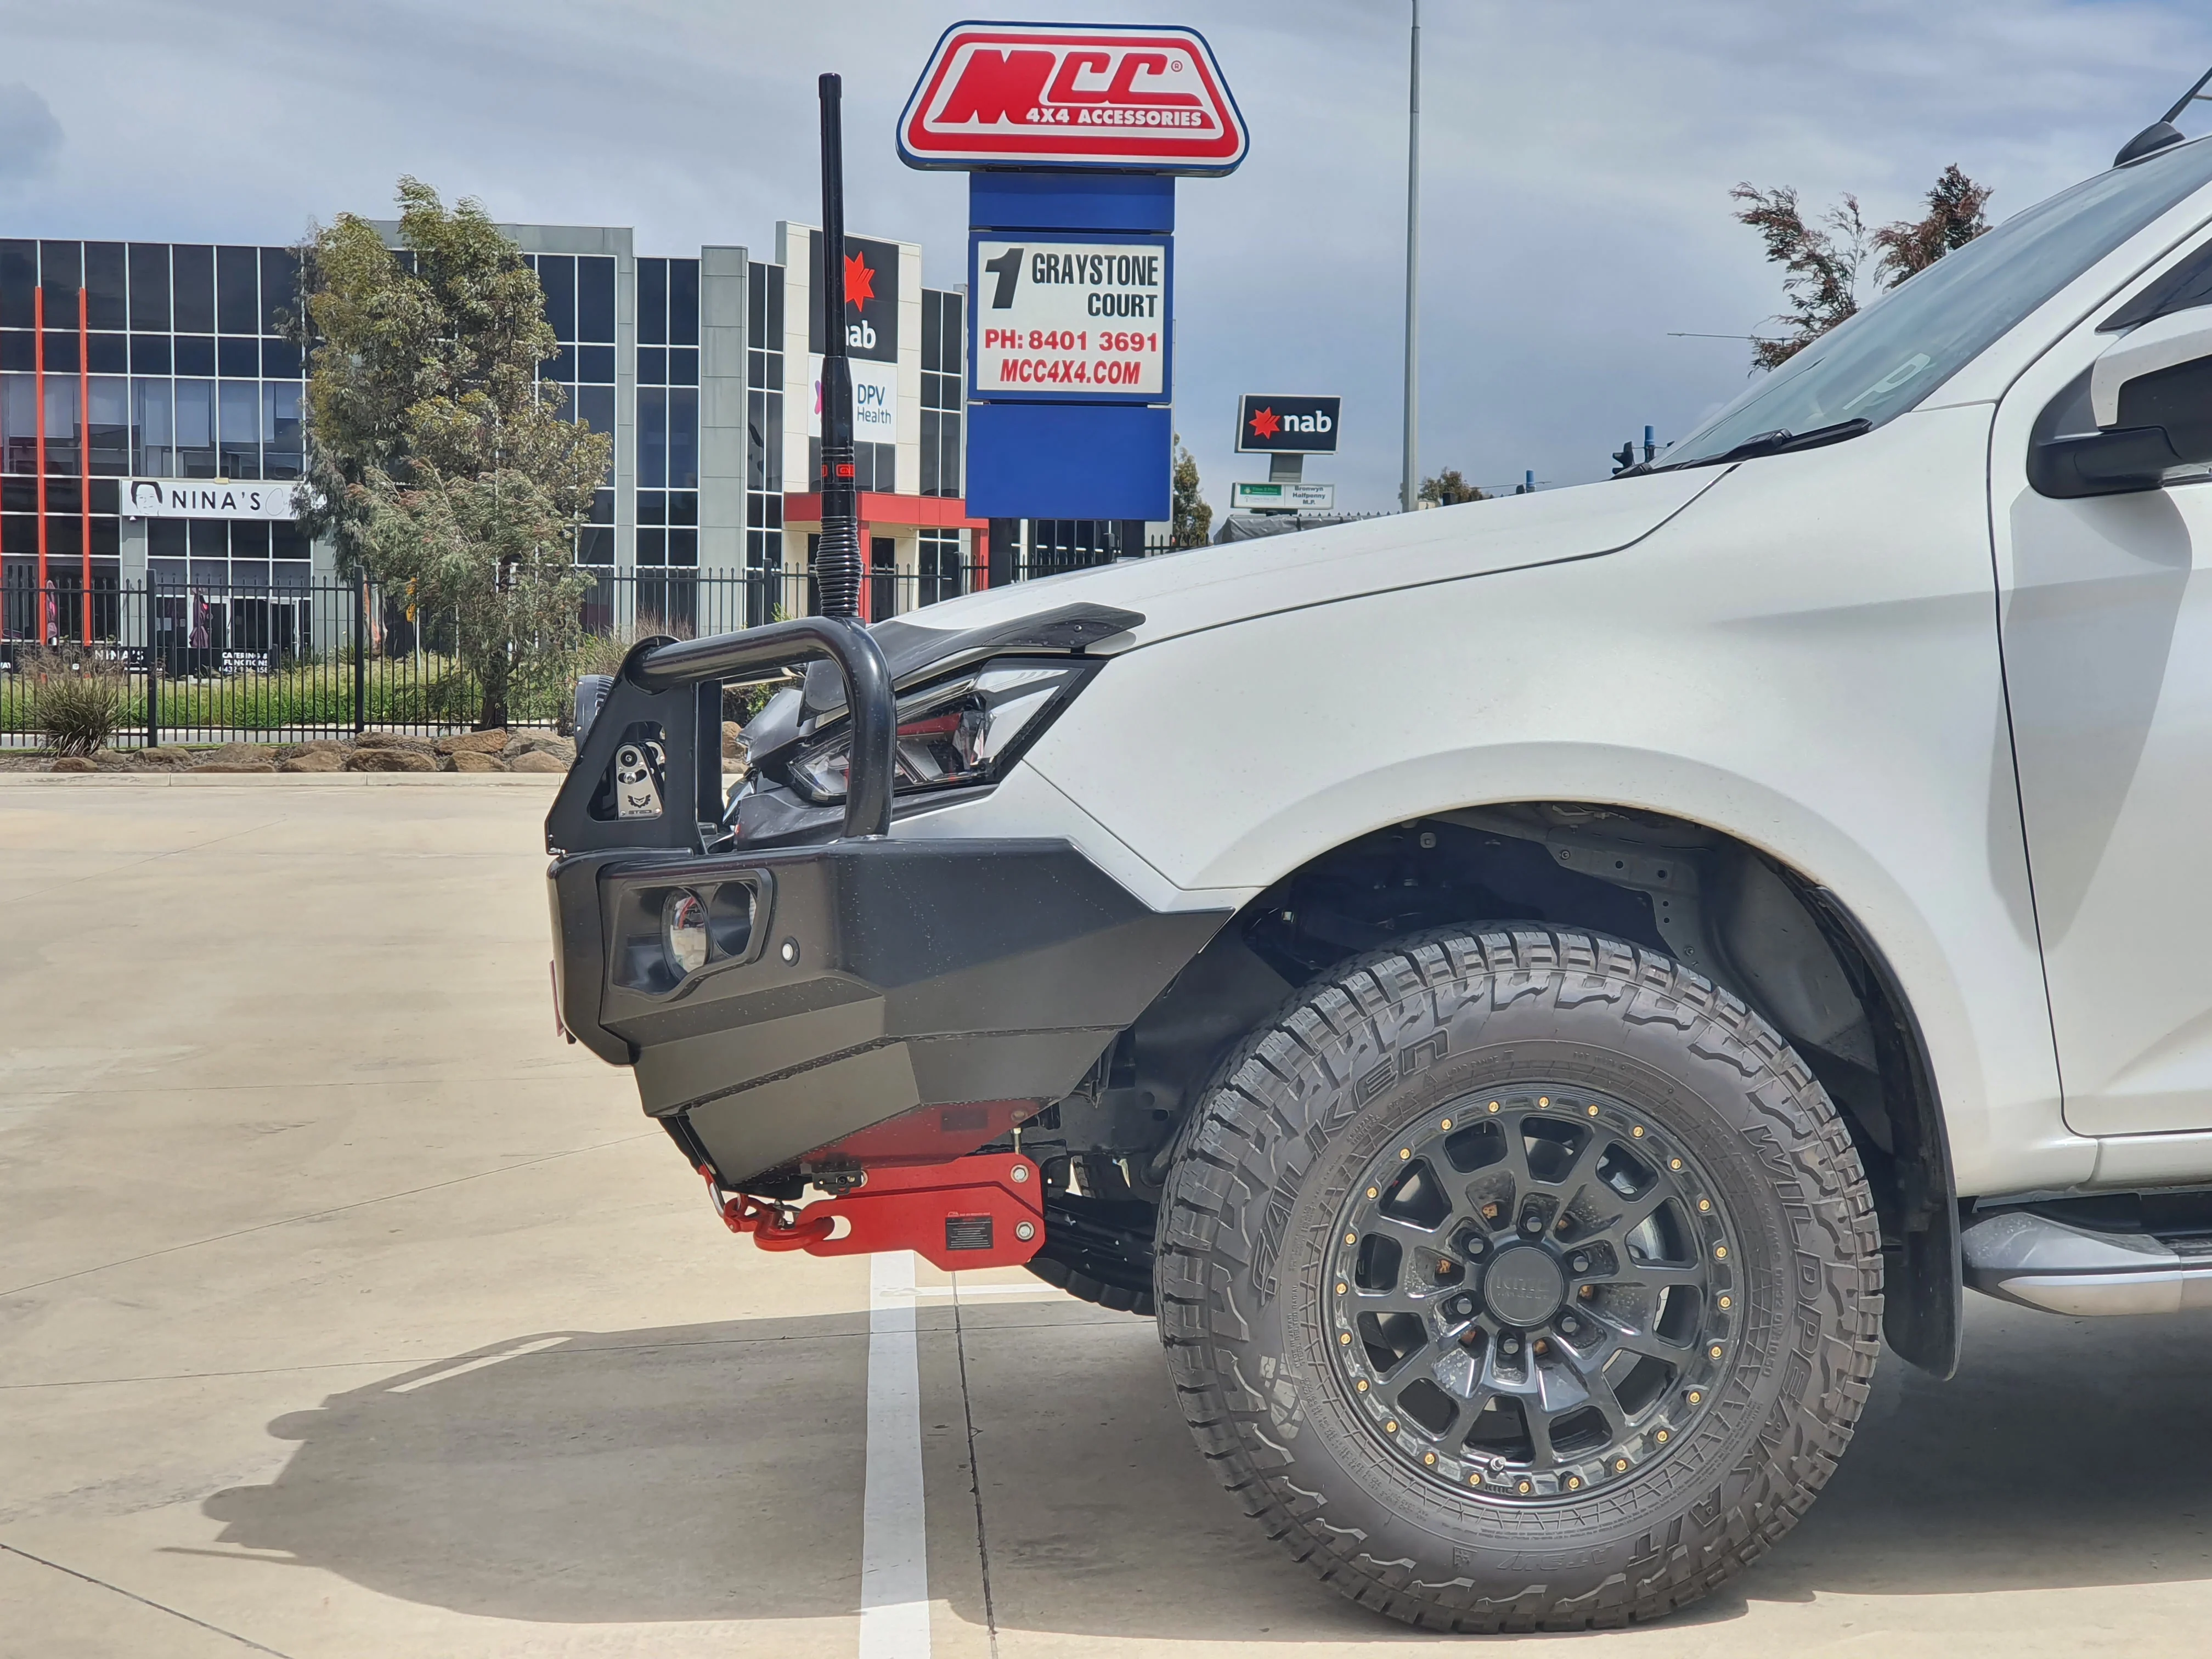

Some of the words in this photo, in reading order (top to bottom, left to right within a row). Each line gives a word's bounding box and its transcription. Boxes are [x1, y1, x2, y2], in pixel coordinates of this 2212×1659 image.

[932, 49, 1203, 123] MCC
[1026, 108, 1070, 123] 4X4
[1077, 109, 1201, 126] ACCESSORIES
[985, 248, 1024, 309] 1
[1032, 253, 1159, 286] GRAYSTONE
[1087, 292, 1158, 317] COURT
[985, 329, 1023, 349] PH:
[1029, 330, 1087, 350] 8401
[1099, 332, 1157, 352] 3691
[1000, 359, 1141, 385] MCC4X4.COM
[857, 383, 885, 406] DPV
[857, 406, 891, 425] Health
[1284, 410, 1332, 433] nab
[172, 490, 261, 511] NINA'S
